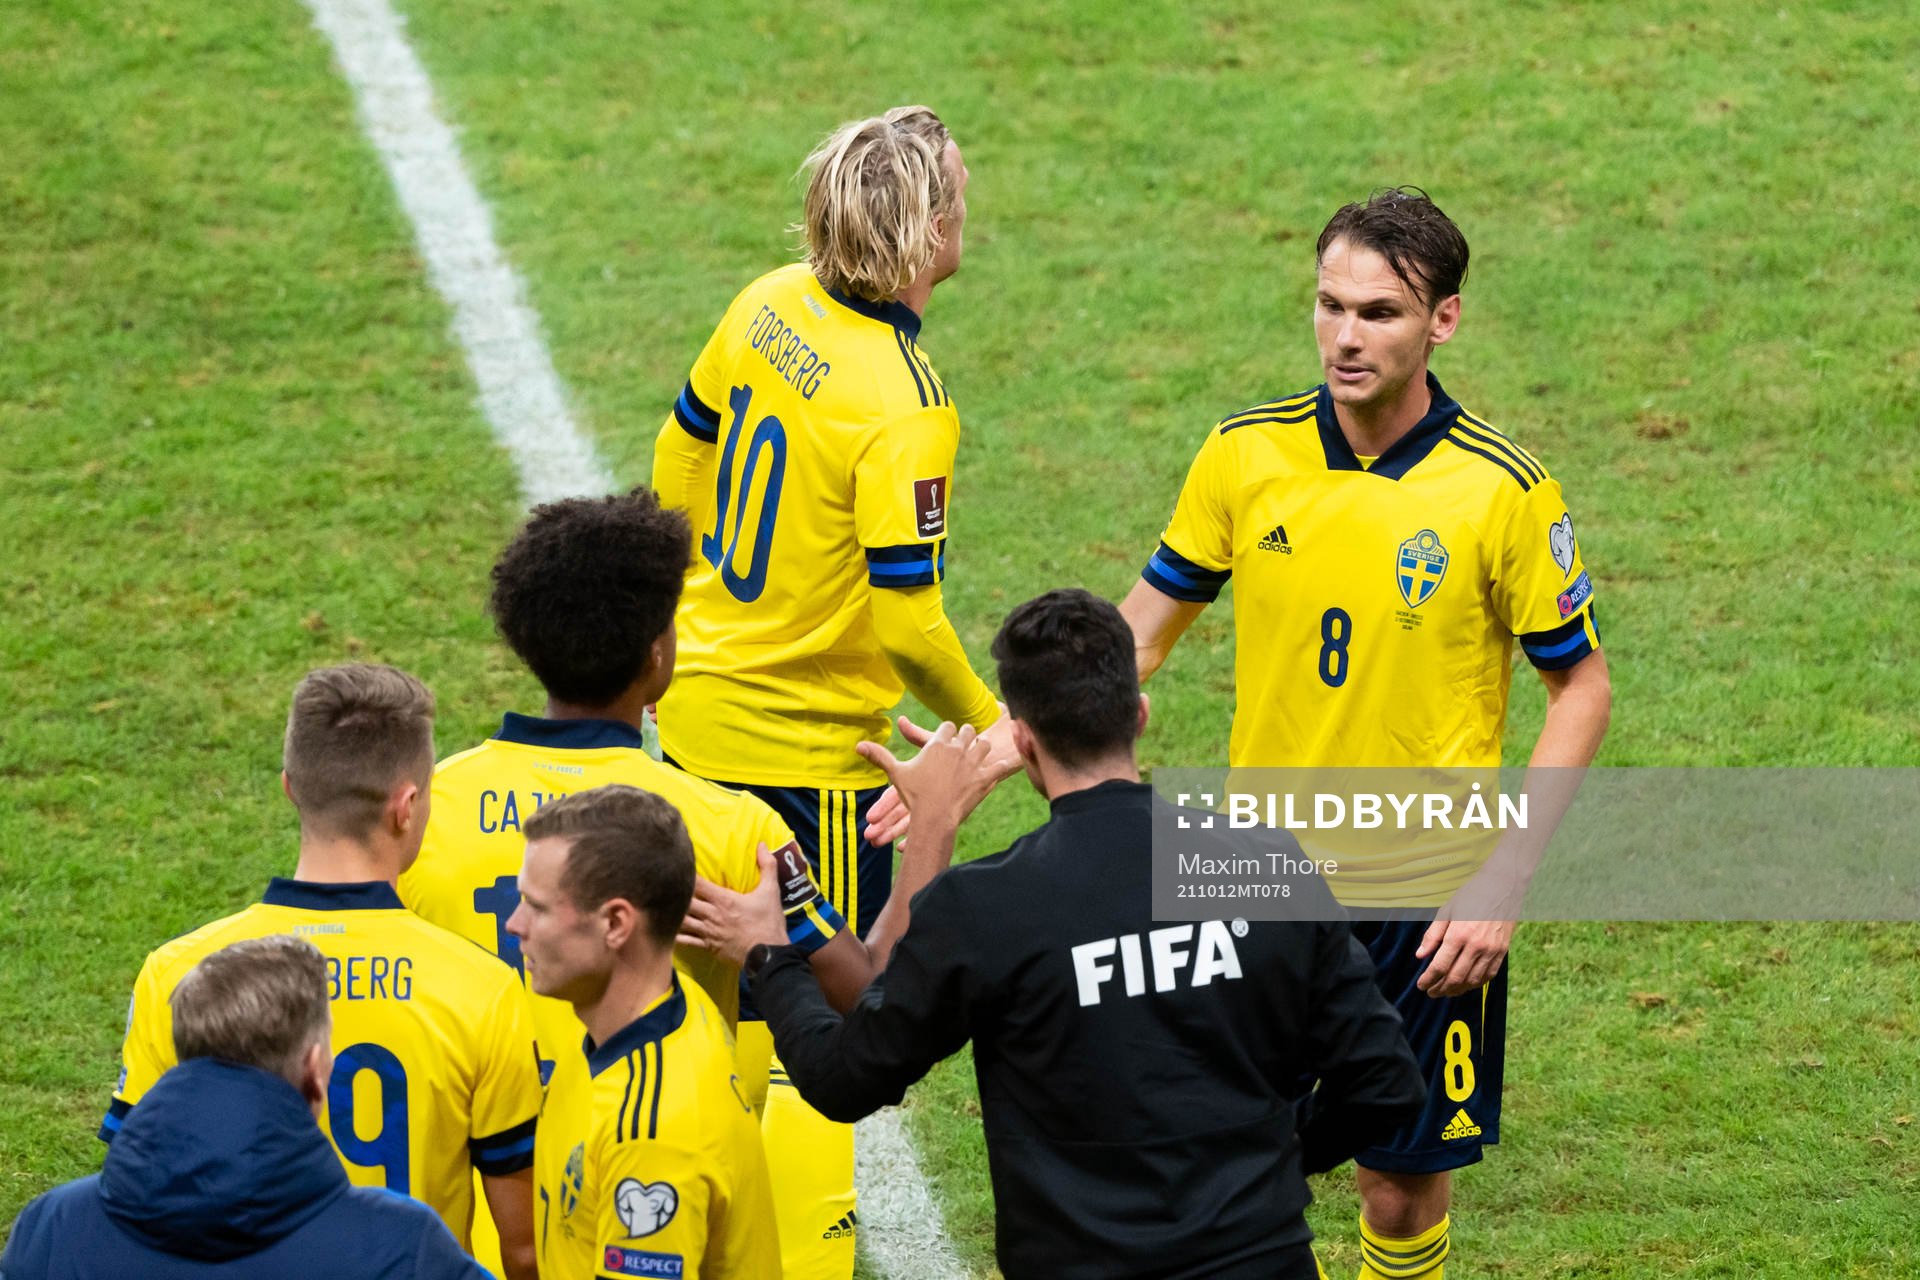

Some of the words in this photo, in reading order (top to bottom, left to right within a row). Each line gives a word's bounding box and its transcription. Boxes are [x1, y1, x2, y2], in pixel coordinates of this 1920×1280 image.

[745, 304, 830, 400] FORSBERG
[702, 384, 786, 603] 10
[1258, 541, 1292, 555] adidas
[1407, 550, 1440, 563] SVERIGE
[1318, 607, 1352, 688] 8
[1444, 1020, 1475, 1102] 8
[1441, 1125, 1481, 1140] adidas
[625, 1255, 682, 1274] RESPECT
